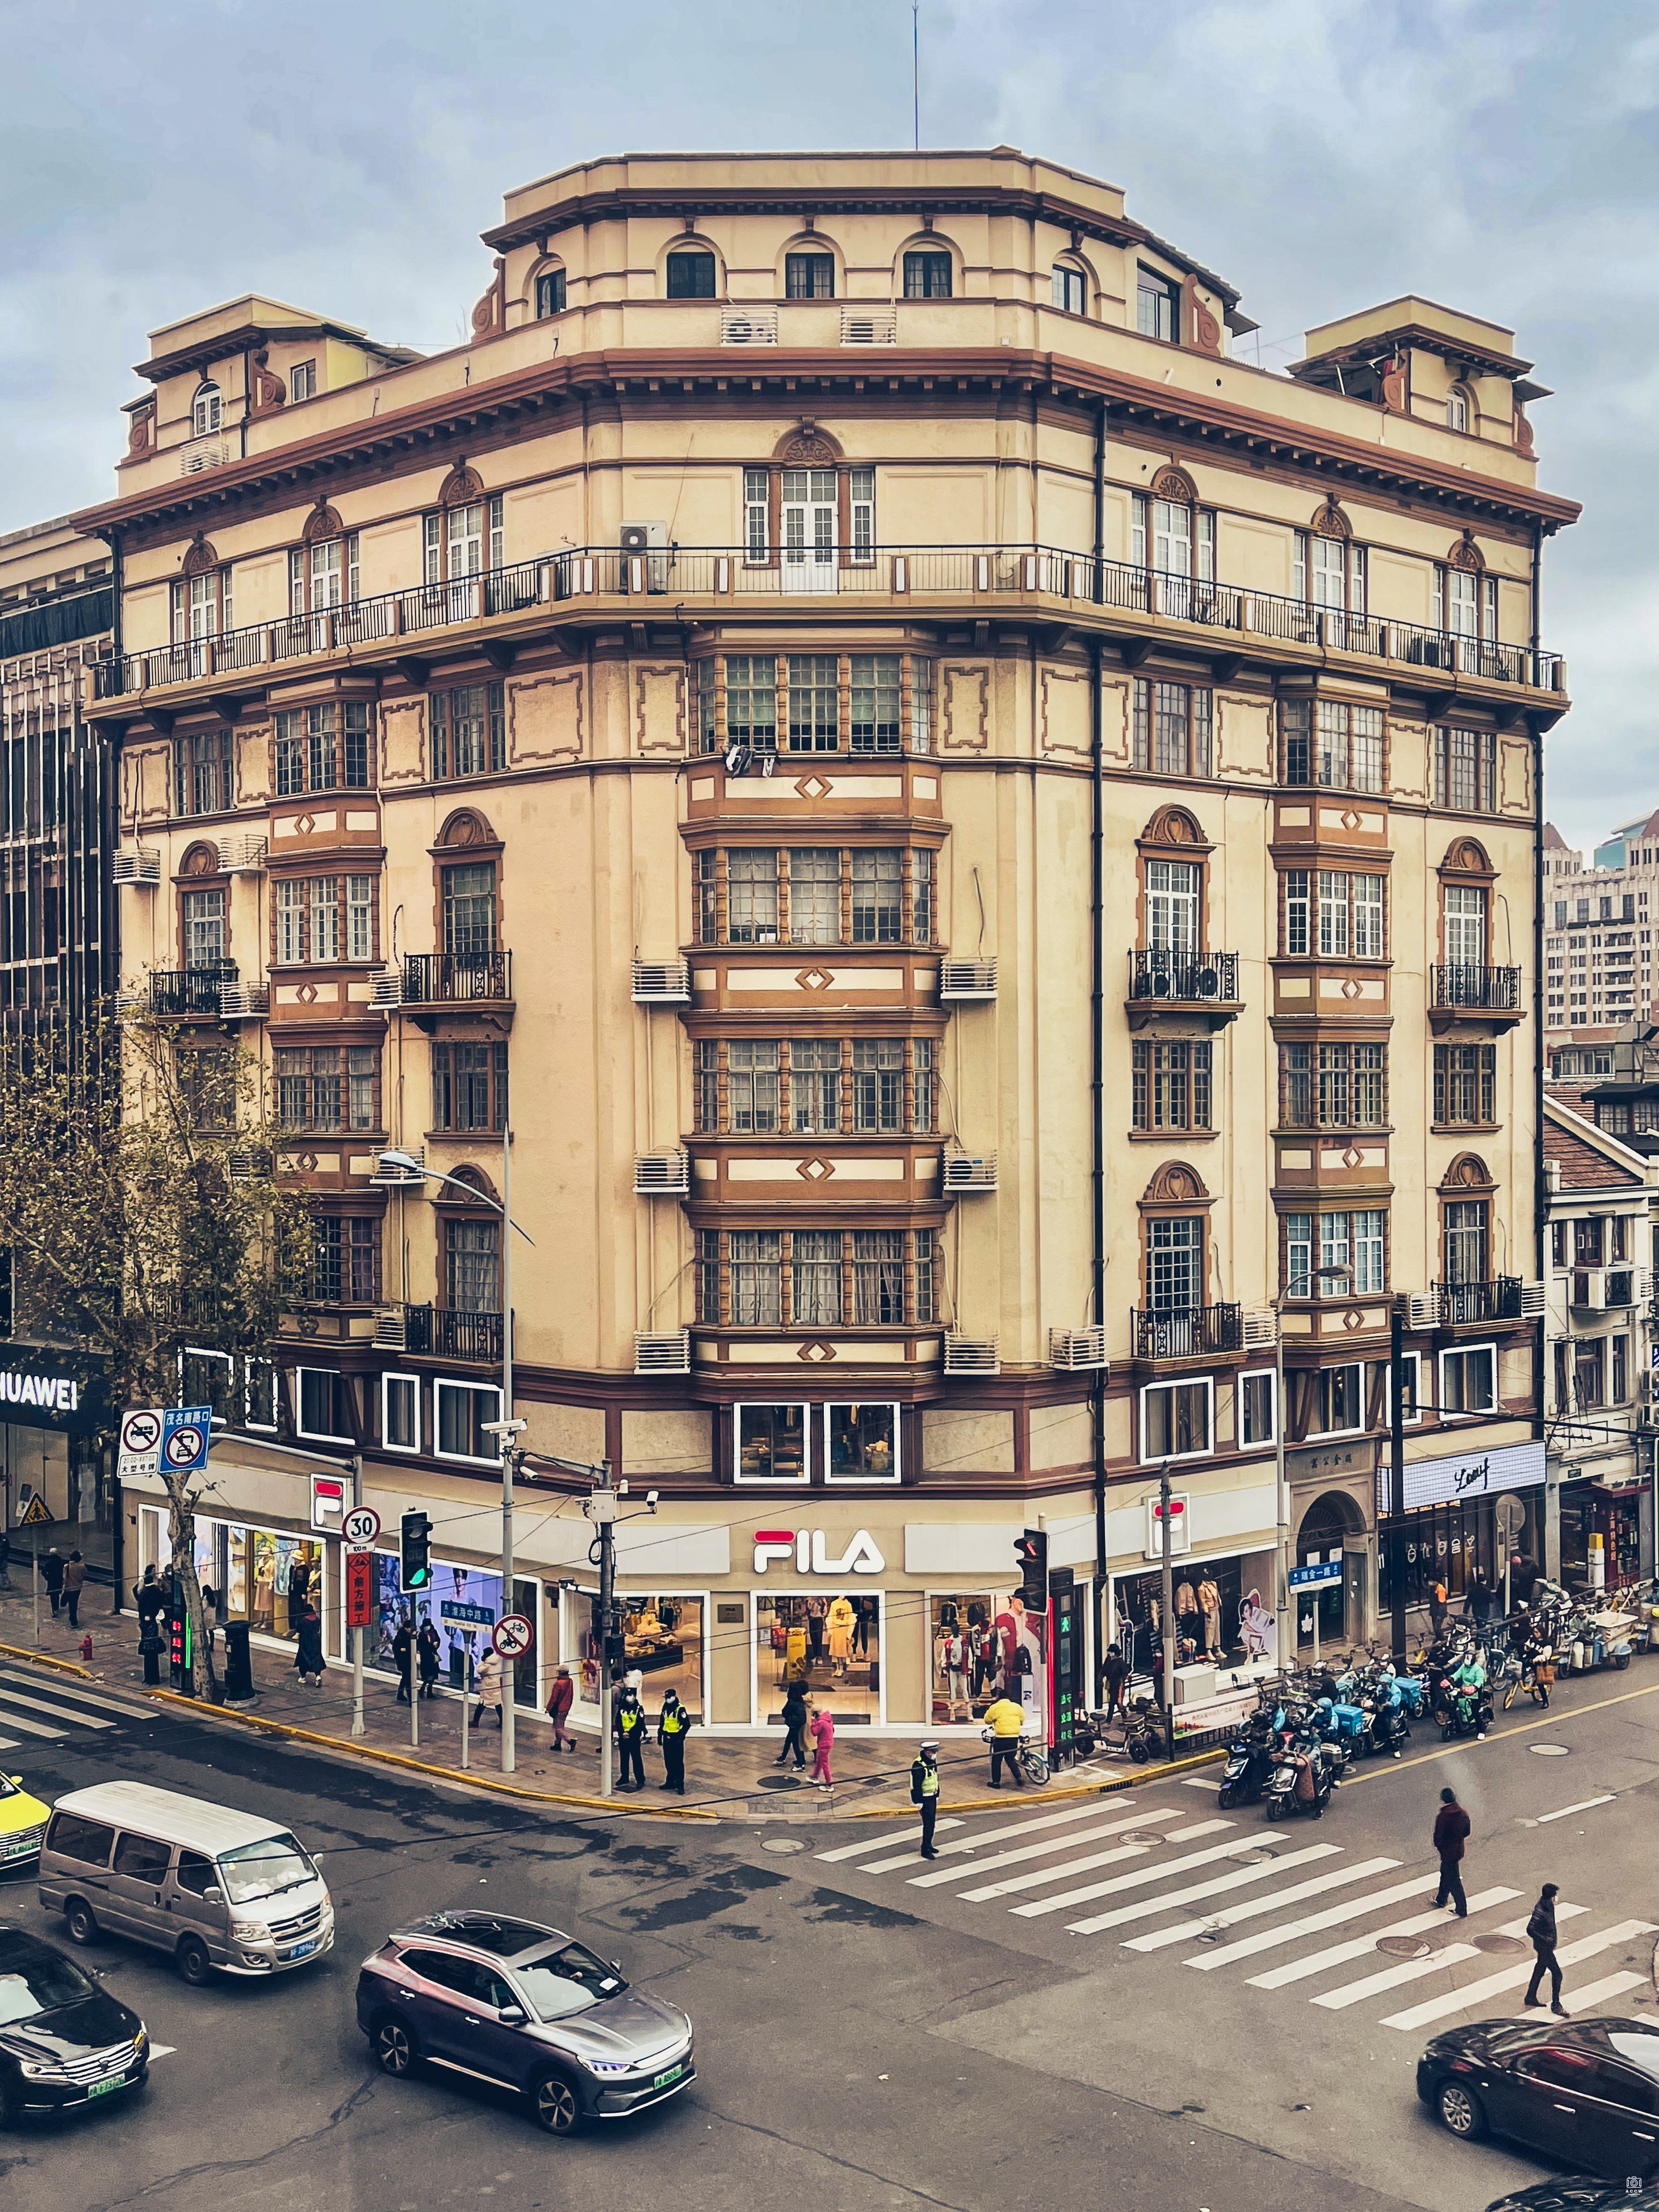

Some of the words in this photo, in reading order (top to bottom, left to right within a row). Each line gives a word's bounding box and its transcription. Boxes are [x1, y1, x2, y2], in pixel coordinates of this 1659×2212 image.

[166, 1411, 210, 1426] 茂名南路口
[351, 1516, 372, 1536] 30
[753, 1528, 886, 1573] FILA
[354, 1577, 365, 1624] 前方施工
